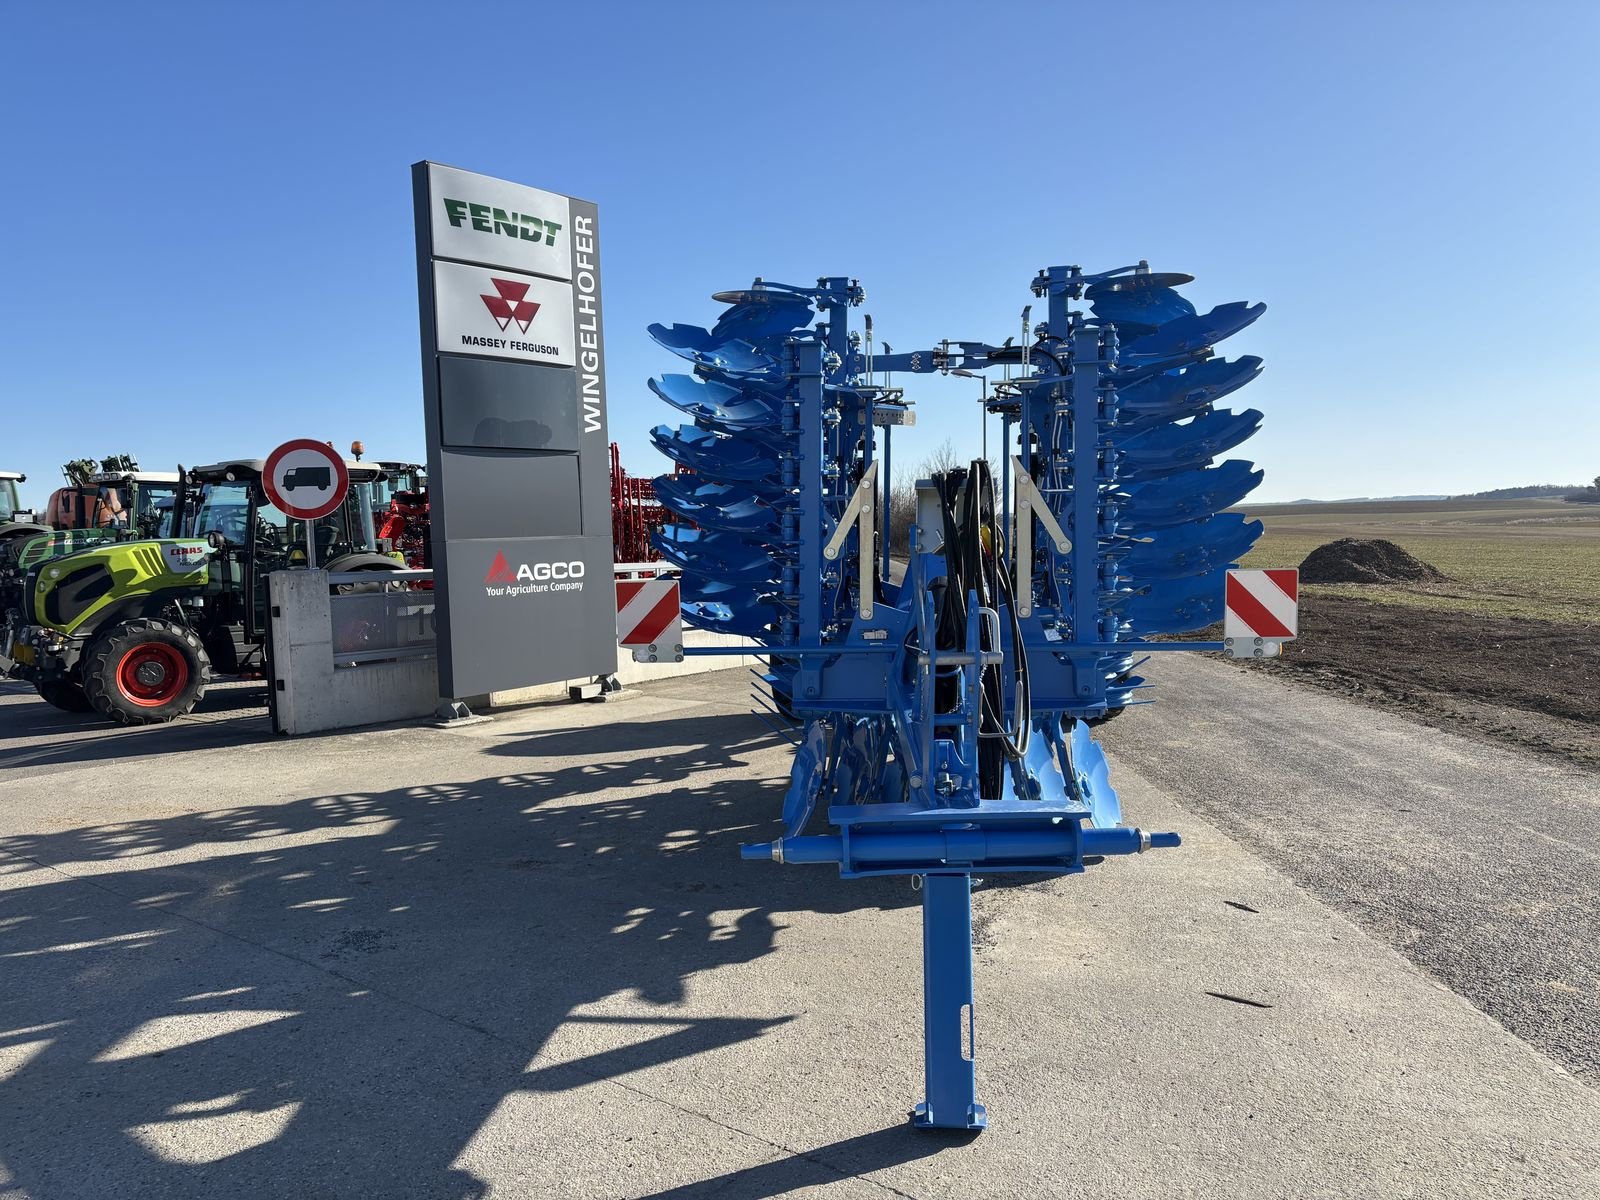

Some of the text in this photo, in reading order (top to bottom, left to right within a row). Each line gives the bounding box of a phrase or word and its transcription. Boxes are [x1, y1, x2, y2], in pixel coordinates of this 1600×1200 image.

[443, 197, 562, 247] FENDT
[575, 215, 601, 433] WINGELHOFER
[461, 335, 559, 356] MASSEY FERGUSON
[516, 561, 585, 582] AGCO
[486, 581, 584, 597] Your Agriculture Company
